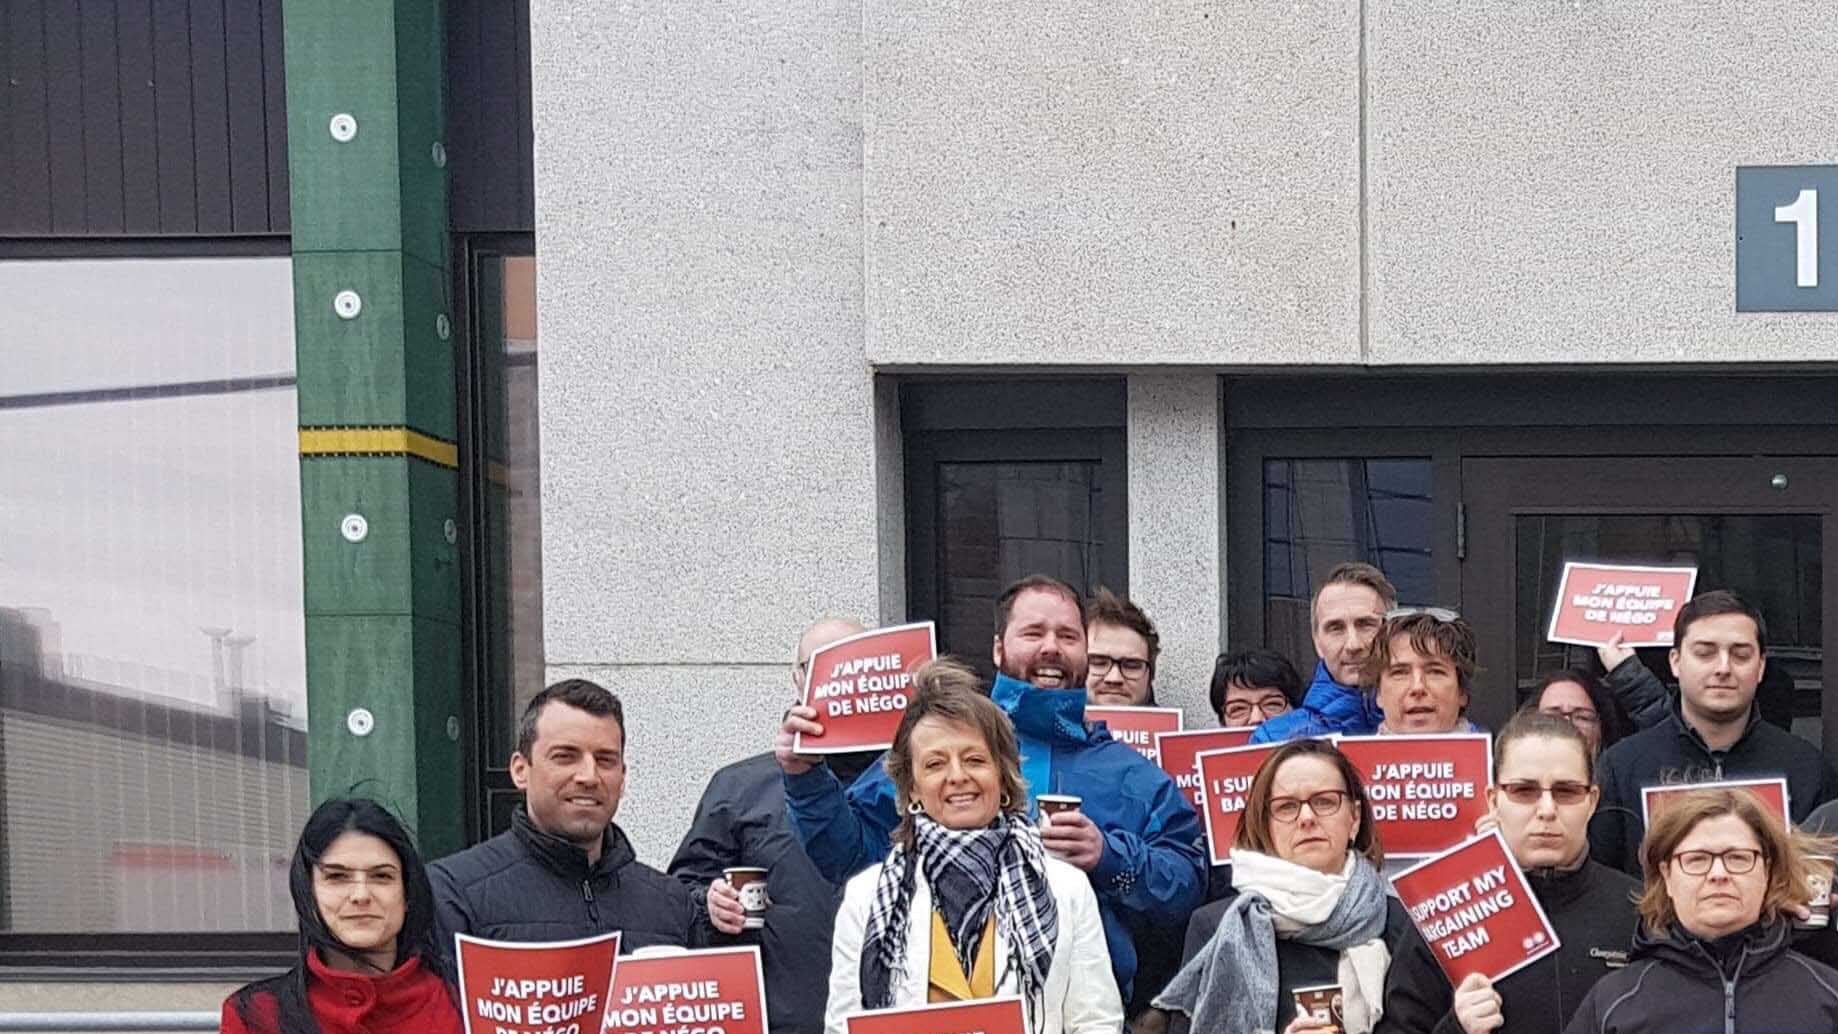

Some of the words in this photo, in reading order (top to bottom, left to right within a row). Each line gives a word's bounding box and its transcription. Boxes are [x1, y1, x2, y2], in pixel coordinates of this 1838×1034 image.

[831, 654, 901, 678] J'APPUIE
[814, 679, 854, 699] MON
[857, 672, 913, 693] ÉQUIP
[828, 700, 853, 717] DE
[856, 693, 908, 713] NÉGO
[1372, 762, 1454, 780] J'APPUIE
[1405, 780, 1475, 799] ÉQUIPE
[1372, 805, 1398, 820] DE
[1402, 800, 1458, 820] NÉGO
[1472, 864, 1506, 894] MY
[1442, 925, 1490, 959] TEAM
[491, 975, 584, 999] J'APPUIE
[621, 980, 720, 1005] J'APPUIE
[477, 998, 522, 1024] MON
[527, 993, 597, 1025] ÉQUIPE
[604, 1006, 657, 1029] MON
[662, 1001, 745, 1023] ÉQUIPE
